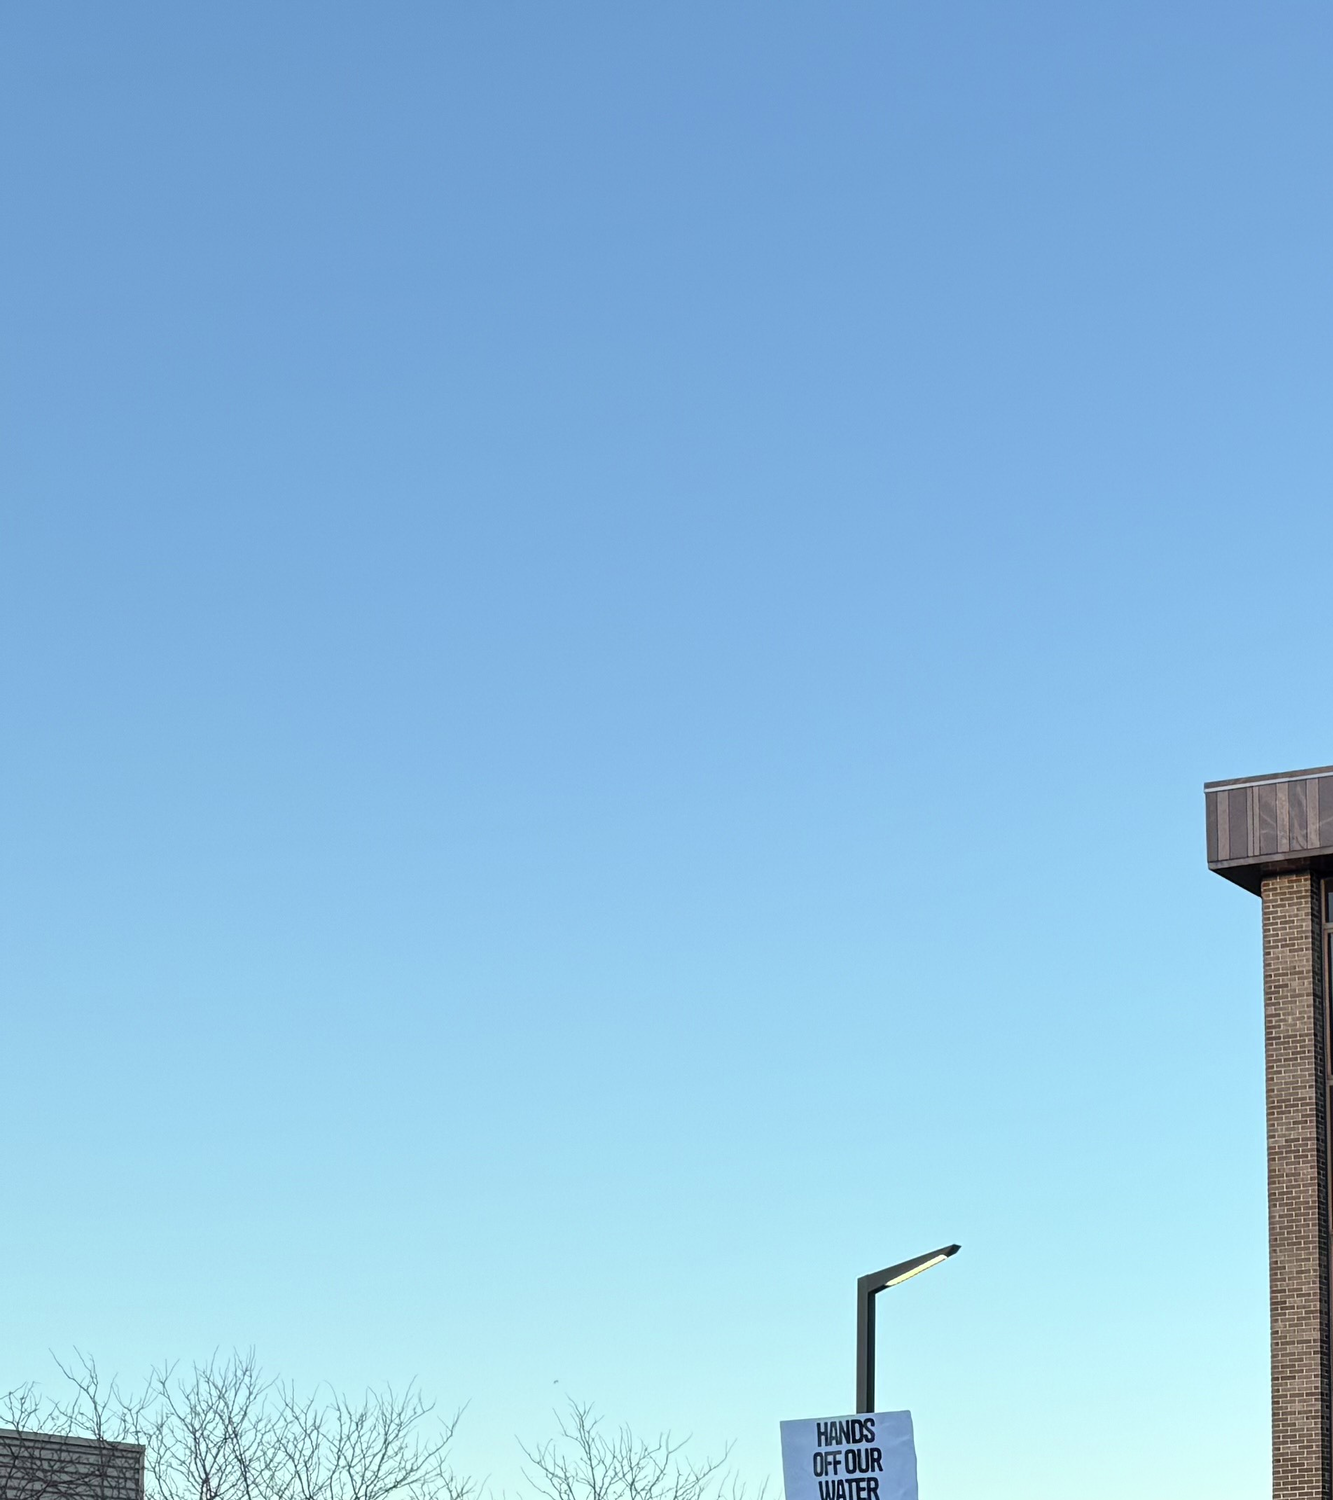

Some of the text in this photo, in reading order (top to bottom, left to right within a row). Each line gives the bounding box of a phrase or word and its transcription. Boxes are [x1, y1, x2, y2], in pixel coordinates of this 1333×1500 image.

[817, 1418, 875, 1447] HANDS
[813, 1448, 883, 1477] OFF OUR
